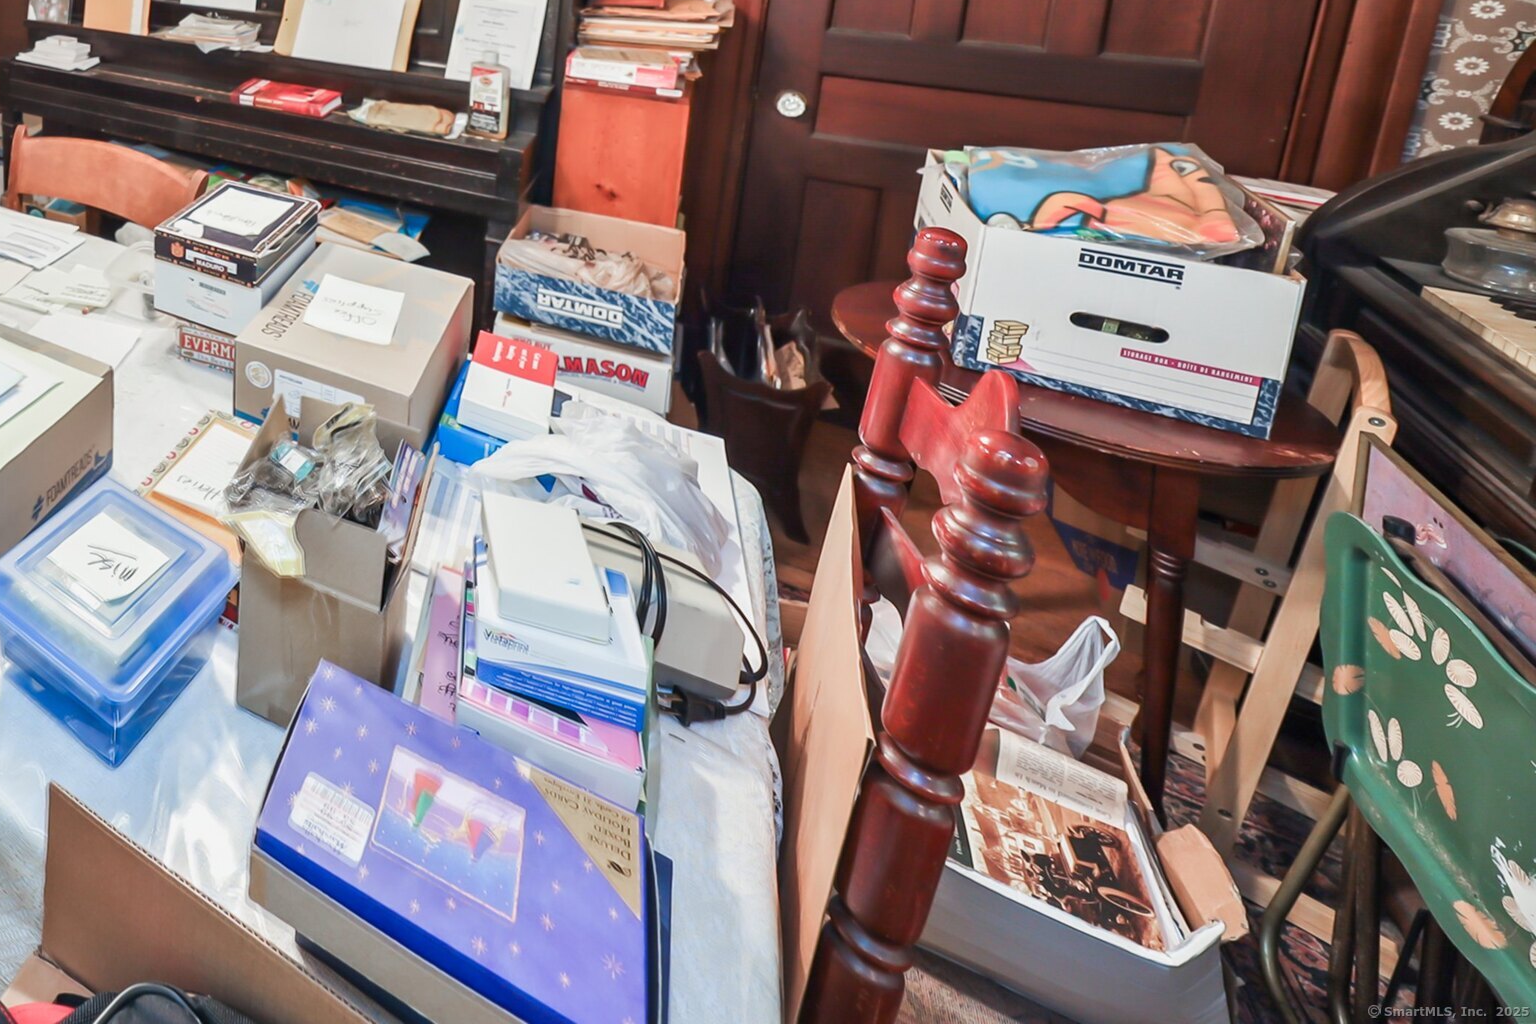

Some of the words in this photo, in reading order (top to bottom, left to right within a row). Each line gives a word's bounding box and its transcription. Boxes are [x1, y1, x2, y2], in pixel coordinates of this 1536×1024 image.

[196, 259, 225, 273] MADURO
[1079, 252, 1184, 280] DOMTAR
[261, 292, 316, 342] FOAMTREADS
[538, 293, 624, 323] DOMTAR
[183, 333, 235, 358] EVERM
[1123, 349, 1151, 359] STORAGE
[1211, 366, 1253, 383] RANGEMENT
[46, 451, 93, 507] FOAMTREADS
